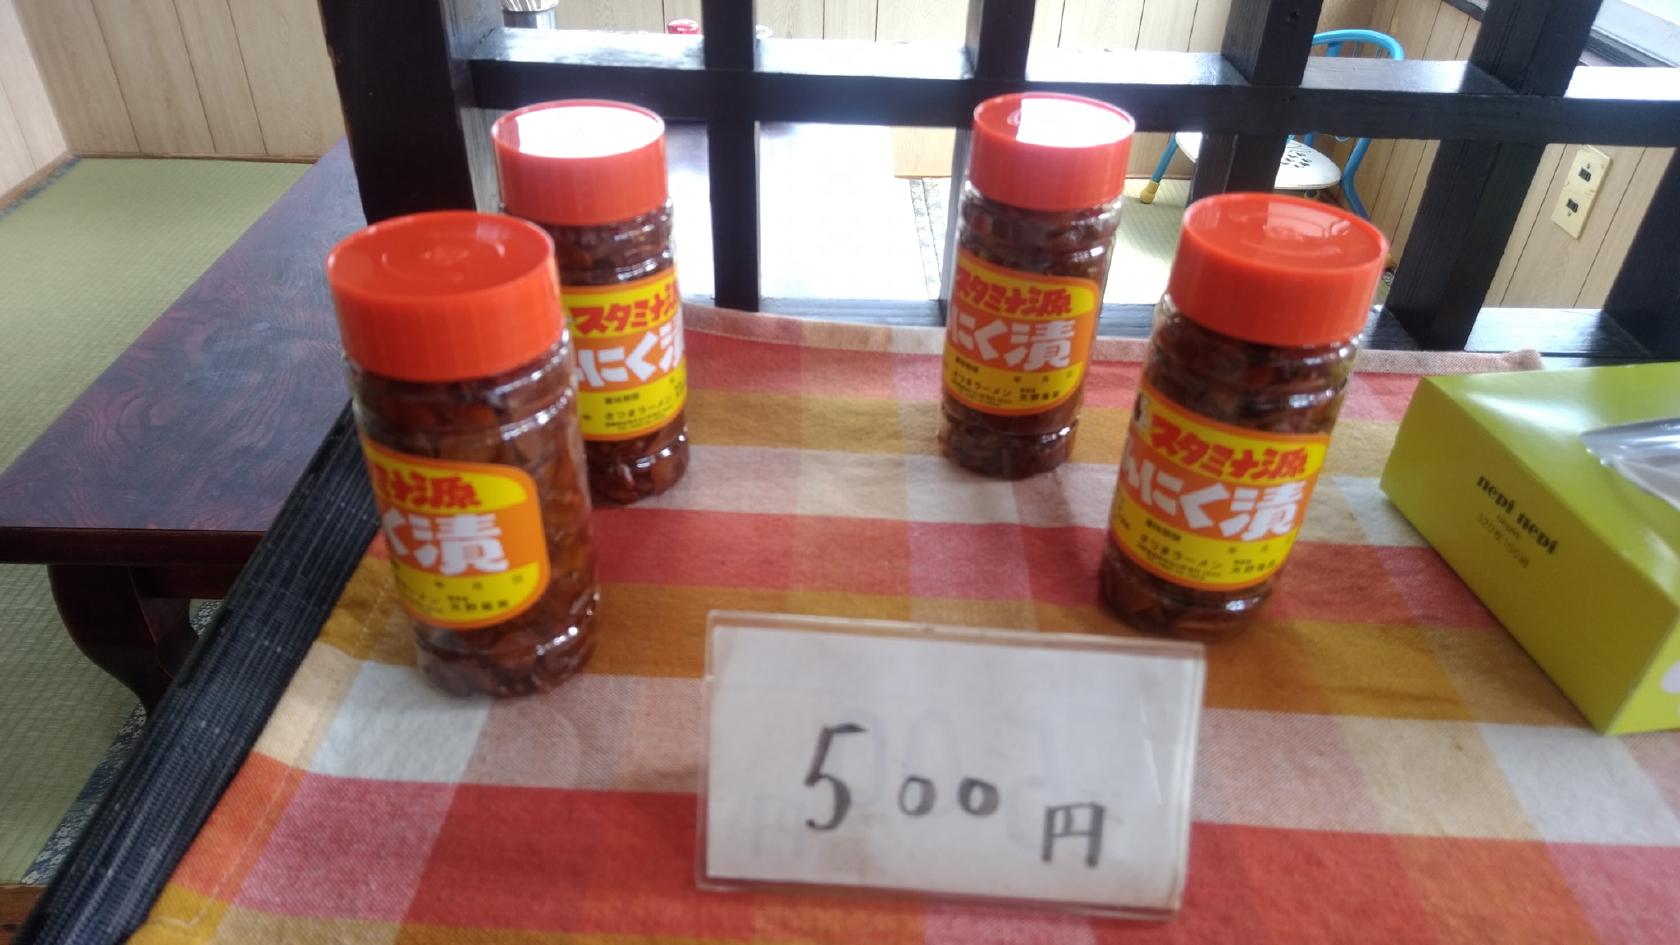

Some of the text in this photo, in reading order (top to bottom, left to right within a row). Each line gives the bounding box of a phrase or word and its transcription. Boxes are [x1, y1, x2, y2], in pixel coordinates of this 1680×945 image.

[1151, 413, 1308, 480] スタミナ源
[1476, 475, 1515, 515] nepi
[1517, 513, 1559, 555] nepi
[803, 721, 1107, 869] 500円
